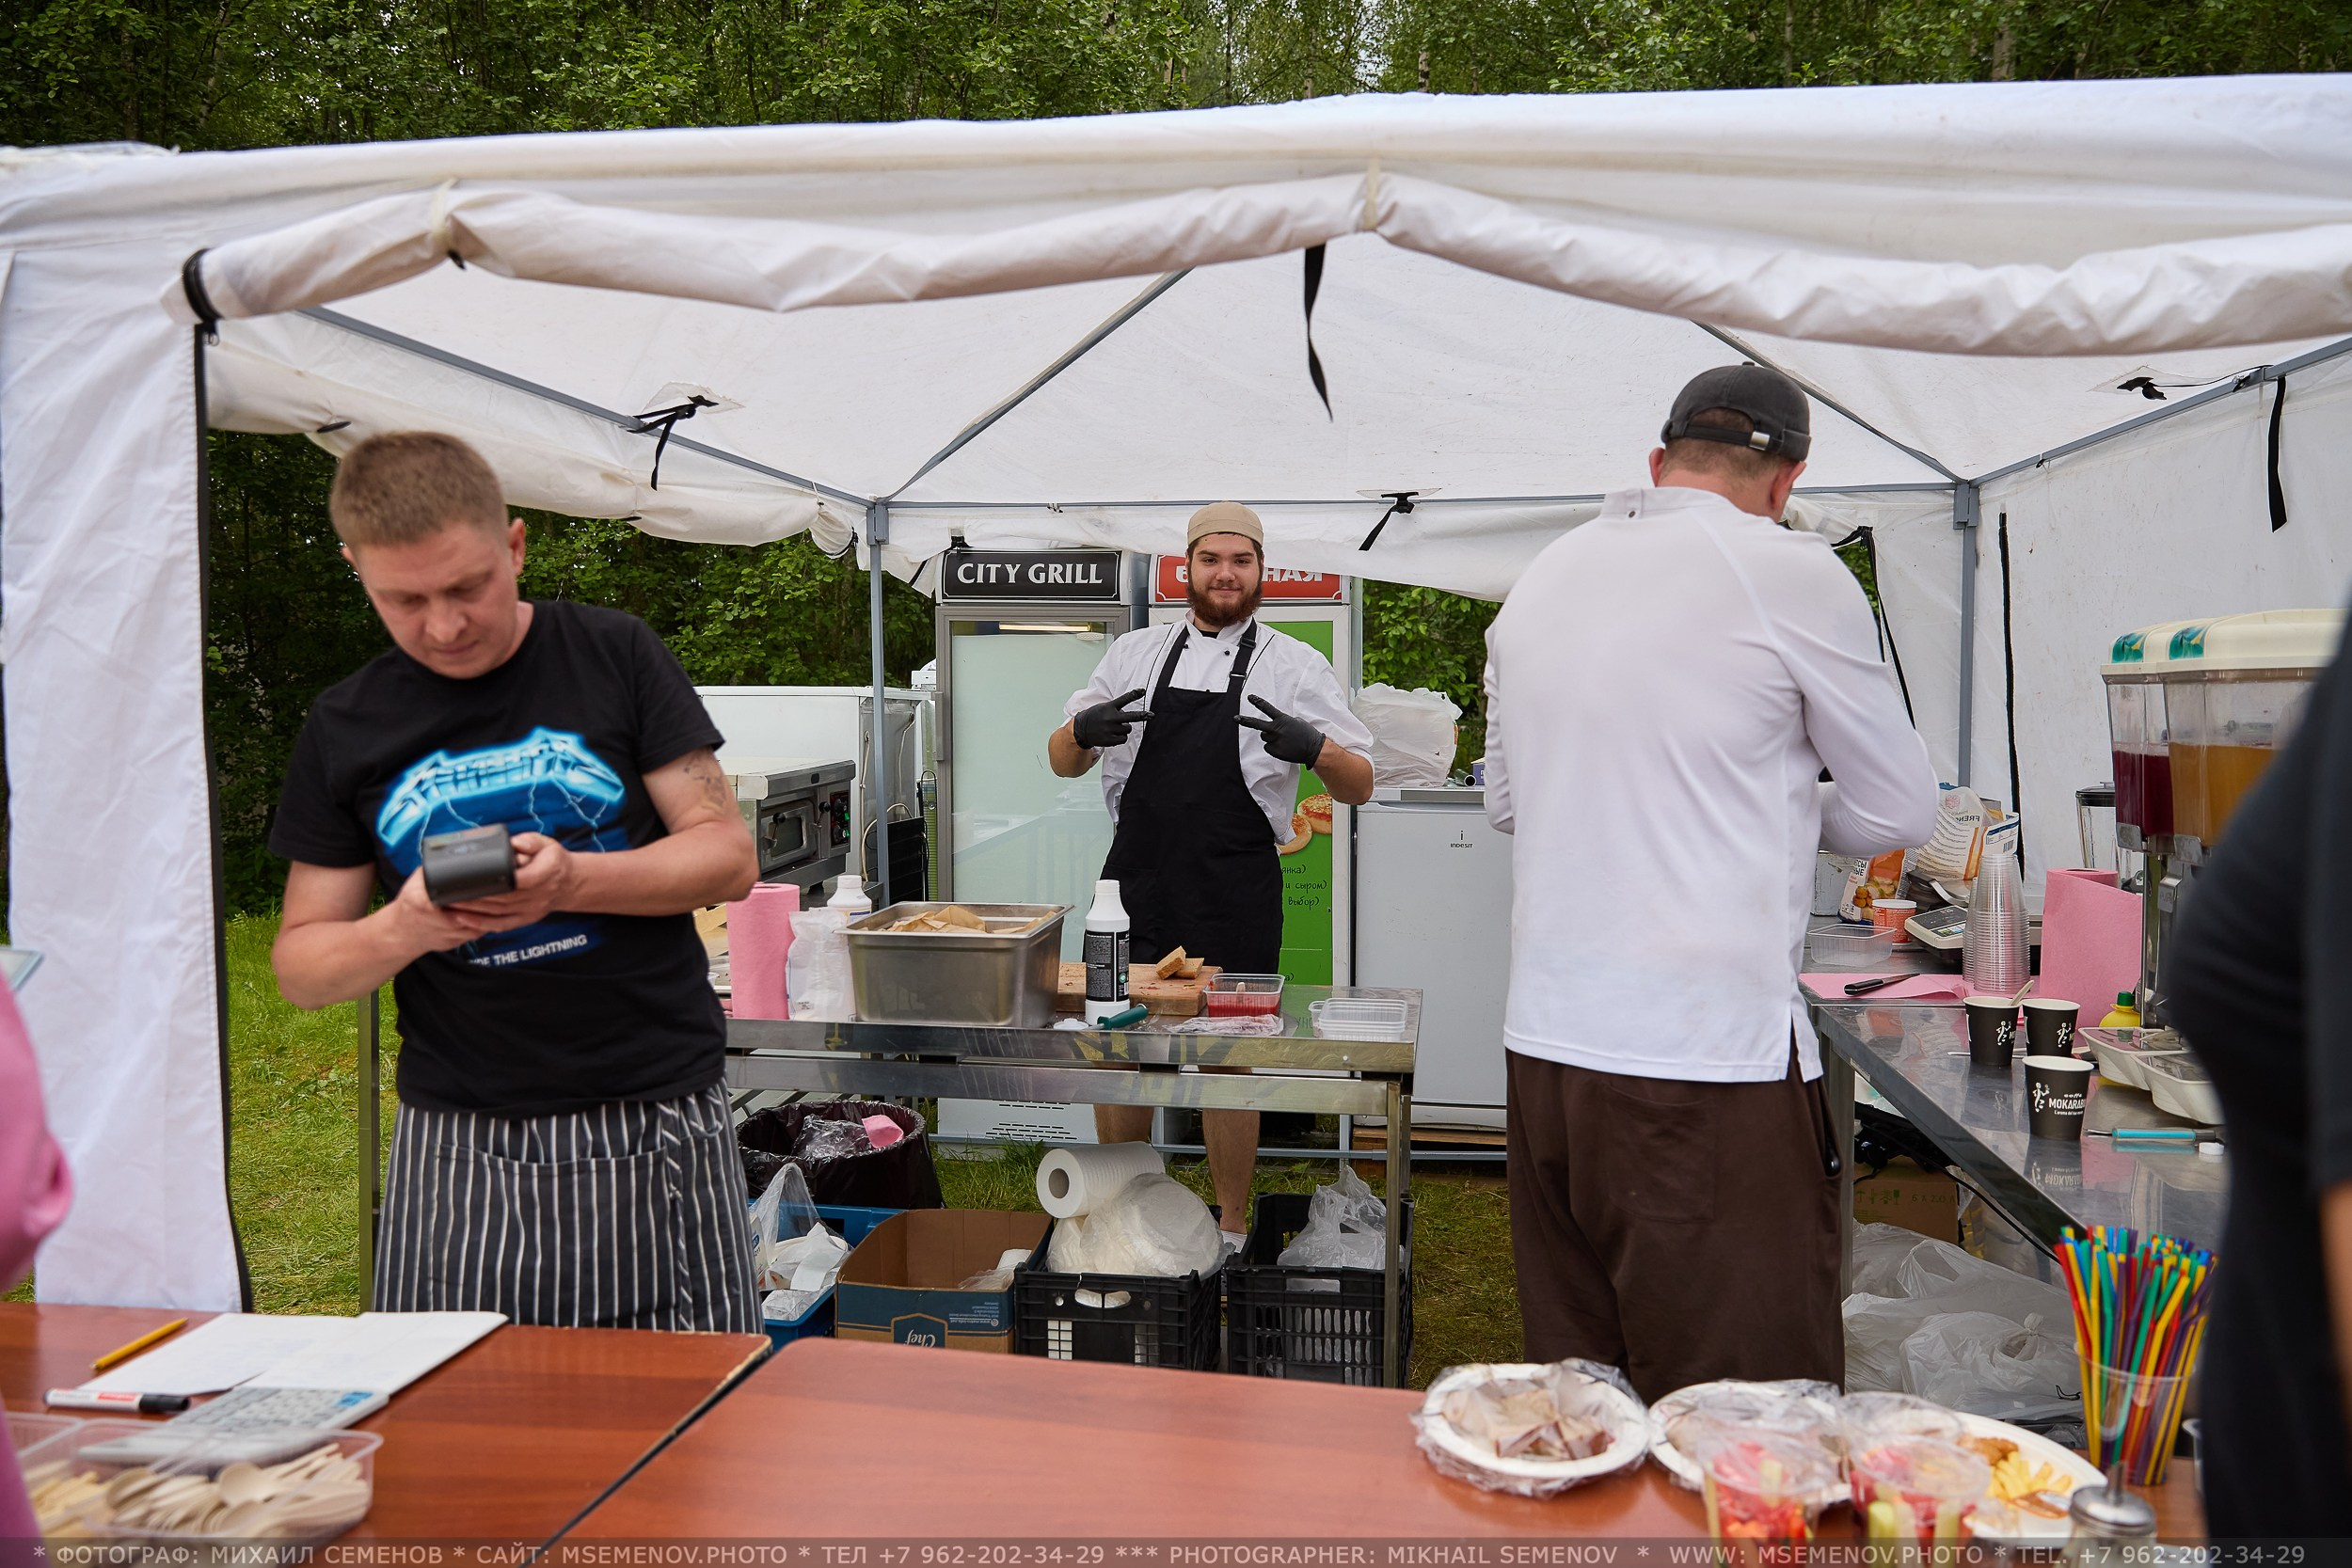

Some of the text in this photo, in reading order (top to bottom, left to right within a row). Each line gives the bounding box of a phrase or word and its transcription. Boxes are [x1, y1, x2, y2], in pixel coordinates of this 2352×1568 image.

[956, 562, 1104, 584] CITY GRILL
[1281, 864, 1307, 874] янка)
[1295, 880, 1327, 894] сыром)
[1288, 895, 1320, 911] выбор)
[494, 950, 518, 966] THE
[520, 934, 588, 960] LIGHTNING
[2048, 1097, 2086, 1110] MOKARAB
[903, 1328, 936, 1348] Chef
